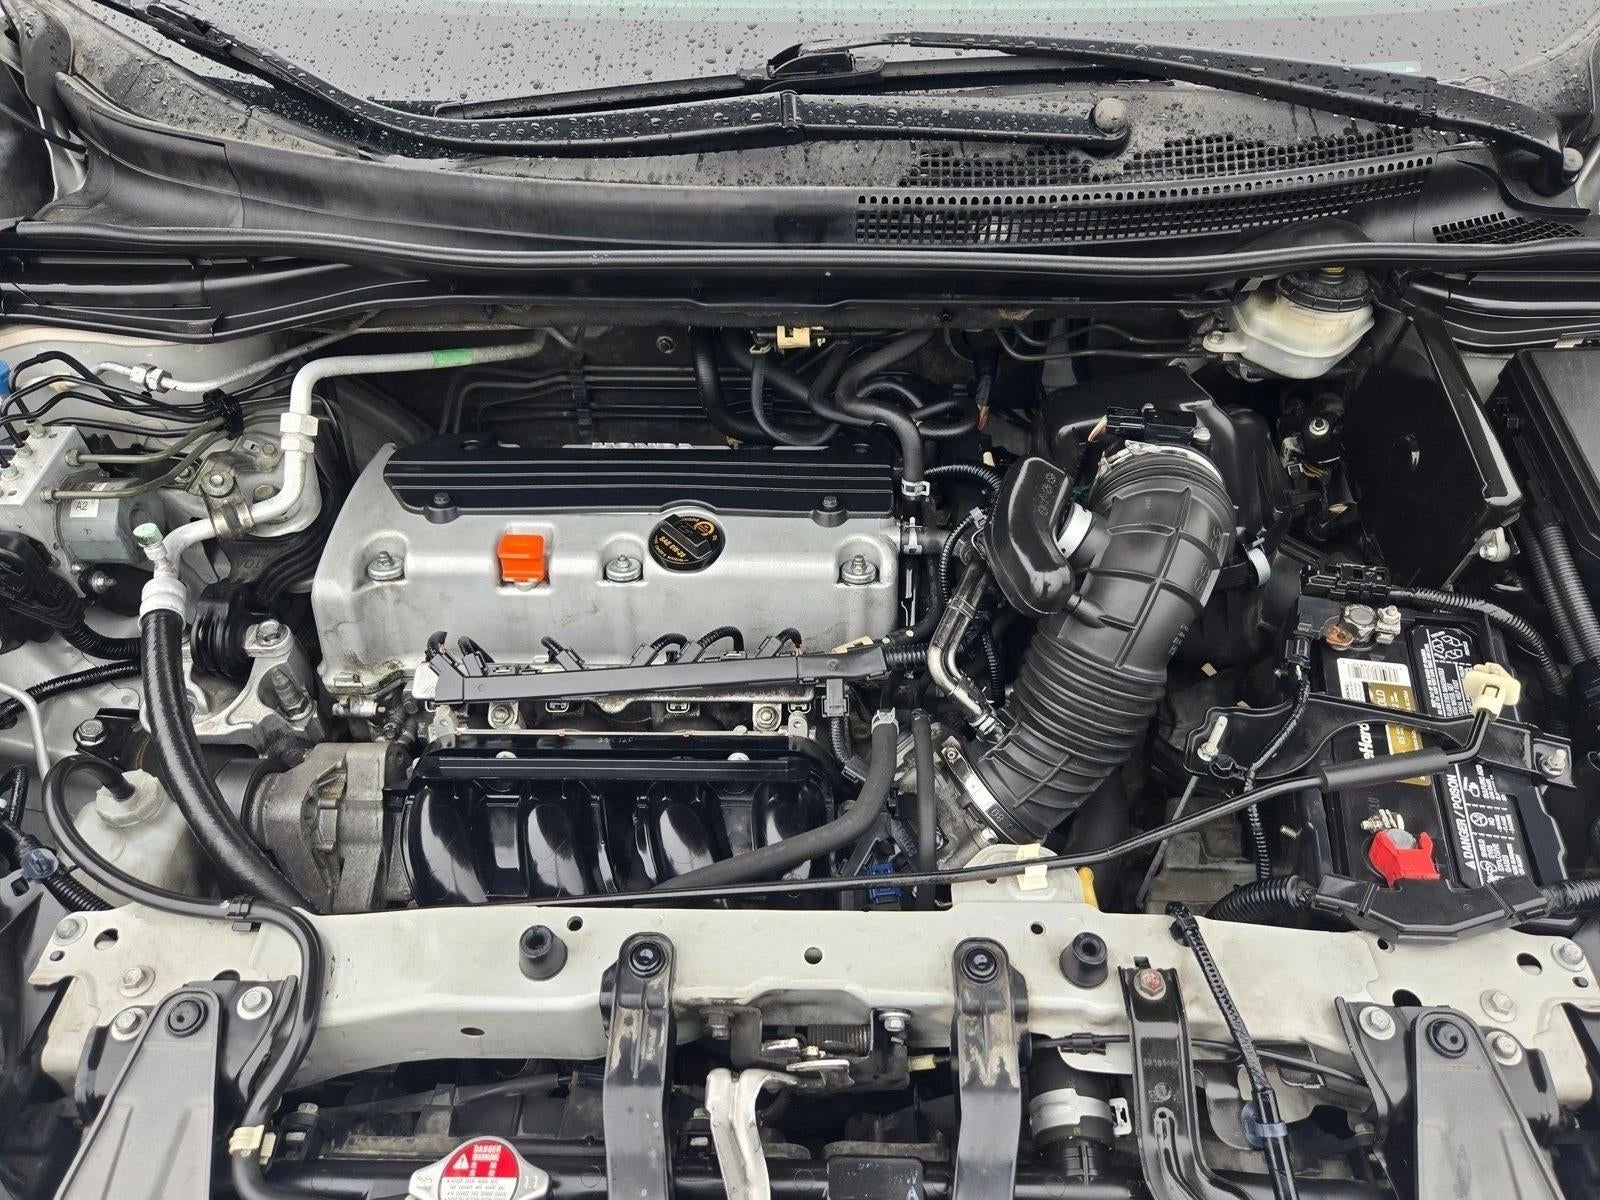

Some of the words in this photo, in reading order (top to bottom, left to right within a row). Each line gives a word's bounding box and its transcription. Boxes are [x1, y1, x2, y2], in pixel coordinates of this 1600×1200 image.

[75, 501, 88, 511] A2
[659, 536, 672, 547] SAE
[1376, 690, 1387, 706] OLD
[1358, 723, 1374, 760] eHard
[1446, 774, 1463, 810] POISON
[990, 808, 1005, 822] 08
[1456, 818, 1474, 859] DANGER
[474, 1145, 501, 1154] DANGER
